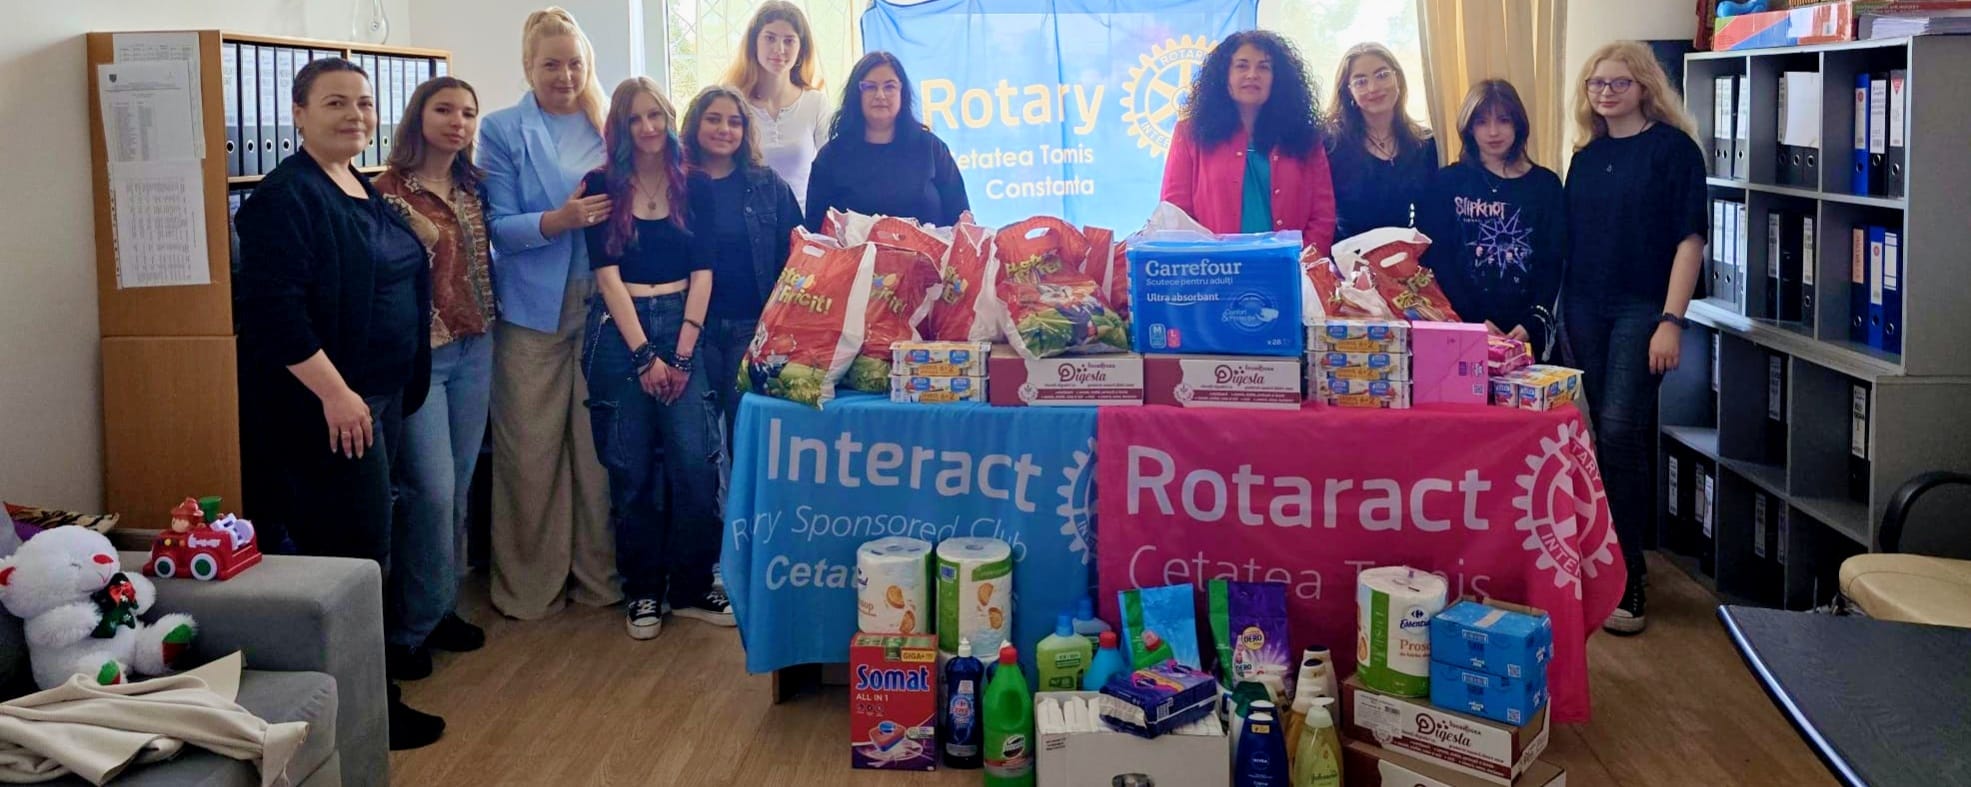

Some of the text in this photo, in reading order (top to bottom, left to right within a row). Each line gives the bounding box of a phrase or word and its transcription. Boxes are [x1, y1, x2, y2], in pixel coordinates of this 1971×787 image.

[1160, 49, 1207, 65] ROTAR
[920, 79, 1105, 135] Rotary
[952, 143, 1094, 171] etatea Tomis
[986, 175, 1095, 200] Constanta
[1144, 258, 1243, 278] Carrefour
[1146, 278, 1179, 287] Scutece
[1180, 278, 1209, 289] pentru
[1147, 291, 1220, 303] Ultra absorbant
[1153, 326, 1162, 334] M
[1170, 330, 1177, 338] L
[1058, 362, 1106, 384] Digesta
[1214, 364, 1264, 386] Digesta
[767, 417, 1042, 513] Interact
[1569, 439, 1602, 483] TARY
[1126, 444, 1493, 532] Rotaract
[791, 505, 960, 543] Sponsored
[765, 554, 859, 591] Ceta
[1128, 544, 1491, 603] Cetatea Tis
[1400, 639, 1430, 651] Pros
[855, 663, 930, 692] Somat
[856, 693, 872, 701] ALL
[874, 694, 883, 702] IN
[1415, 712, 1472, 748] Digesta
